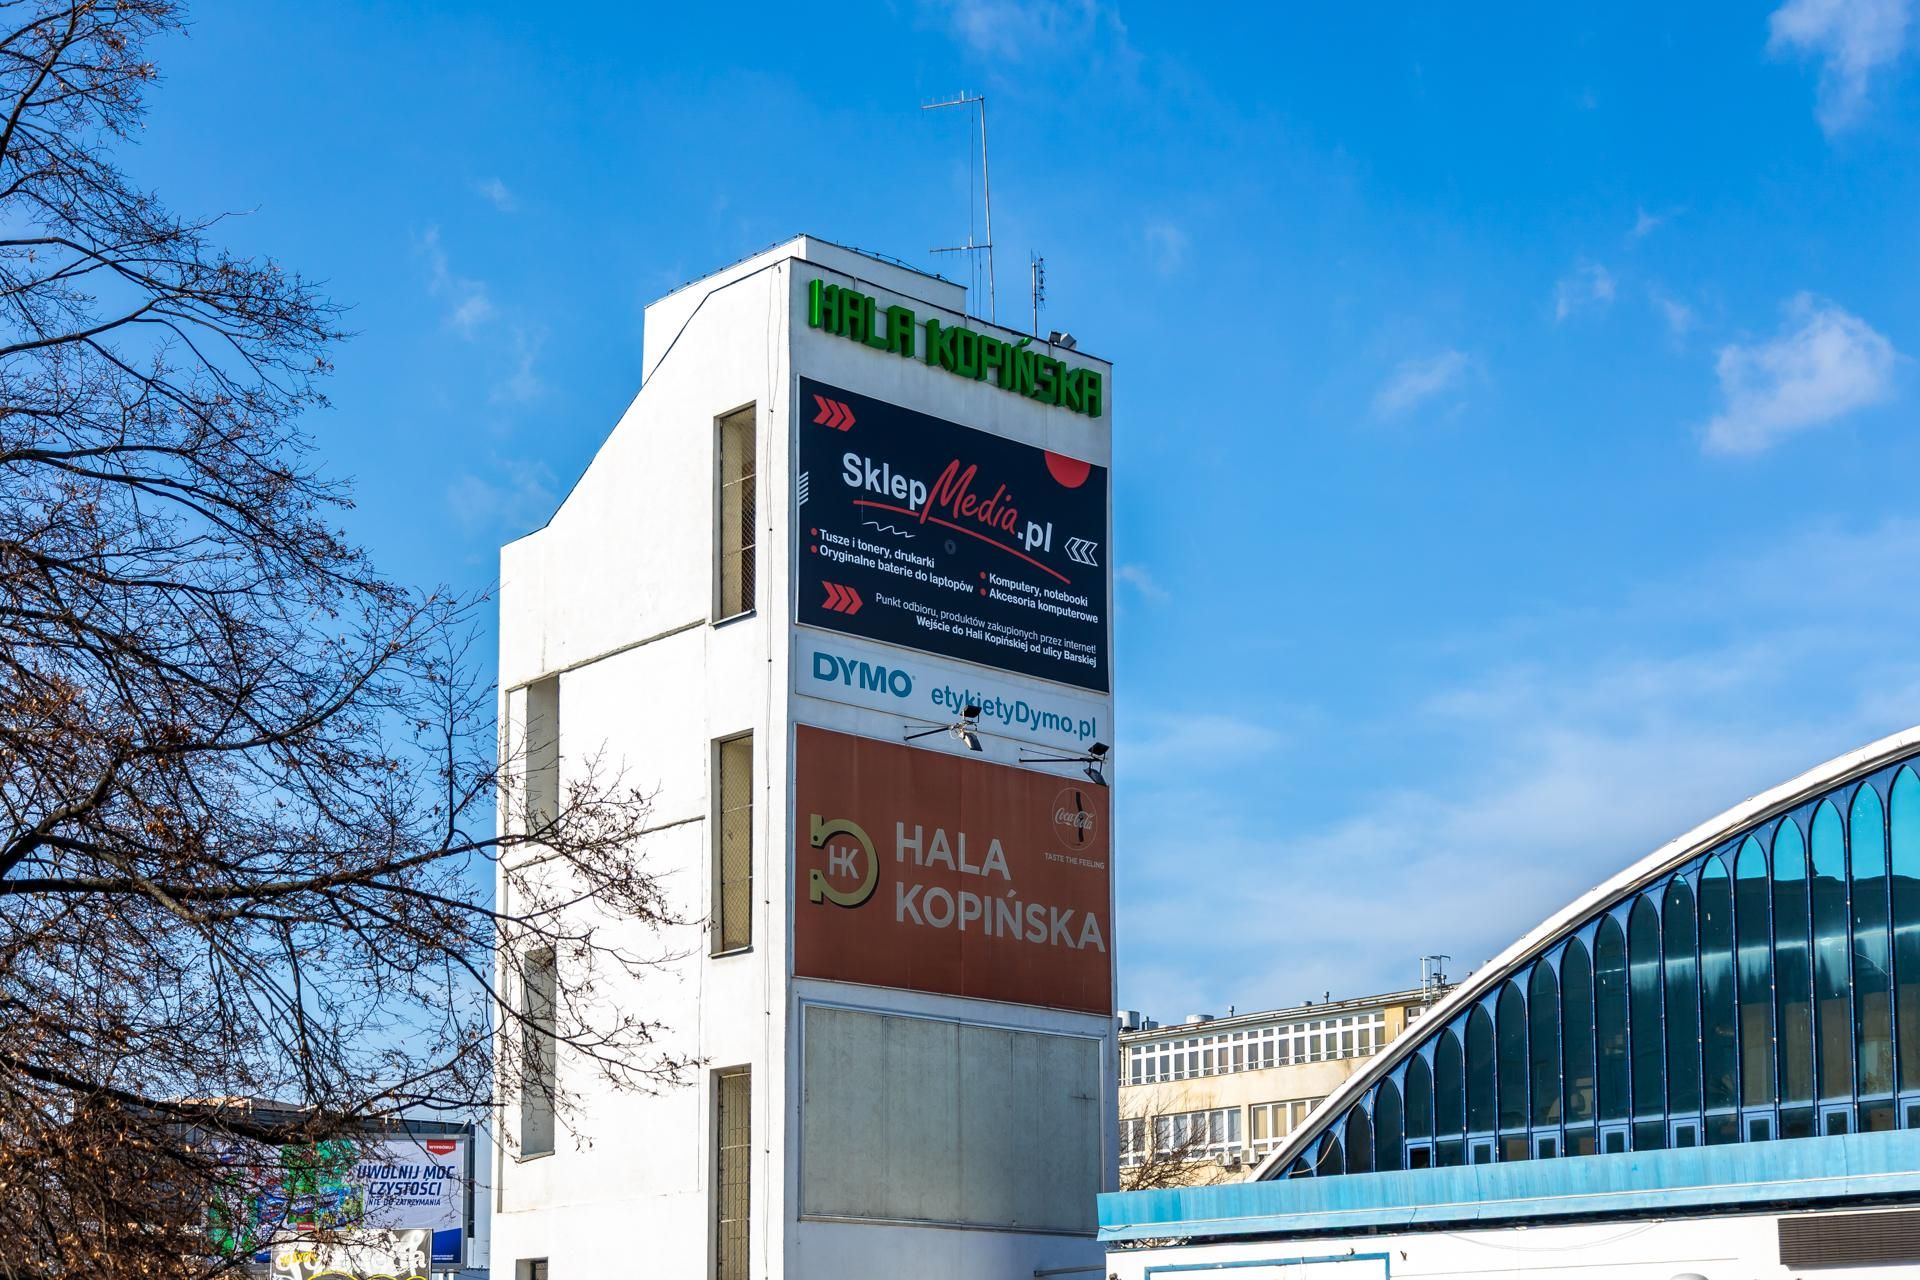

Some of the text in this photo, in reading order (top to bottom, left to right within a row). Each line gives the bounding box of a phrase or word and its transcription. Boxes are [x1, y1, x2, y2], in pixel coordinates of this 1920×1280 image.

[809, 279, 1102, 418] HALA KOPIŃSKA
[819, 529, 935, 568] Tusze i tonery, drukarki
[819, 545, 974, 593] Oryginalne baterie do laptopów
[989, 573, 1088, 607] Komputery, notebooki
[989, 588, 1099, 624] Akcesoria komputerowe
[875, 592, 1097, 654] Punkt odbioru, produktów zakupionych przez internet!
[916, 615, 1097, 669] Wejście do Hali Kopińskiej od ulicy Barskiej
[813, 651, 912, 698] DYMO
[931, 684, 1096, 741] etykietyDymo.pl
[896, 821, 1011, 881] HALA
[1044, 852, 1105, 870] TASTE THE FEELING
[896, 881, 1105, 953] KOPIŃSKA
[356, 1165, 455, 1180] UWOLNIJ MOC
[368, 1177, 442, 1196] CZYSTOŚCI
[395, 1198, 441, 1206] ZATRZYMANIA
